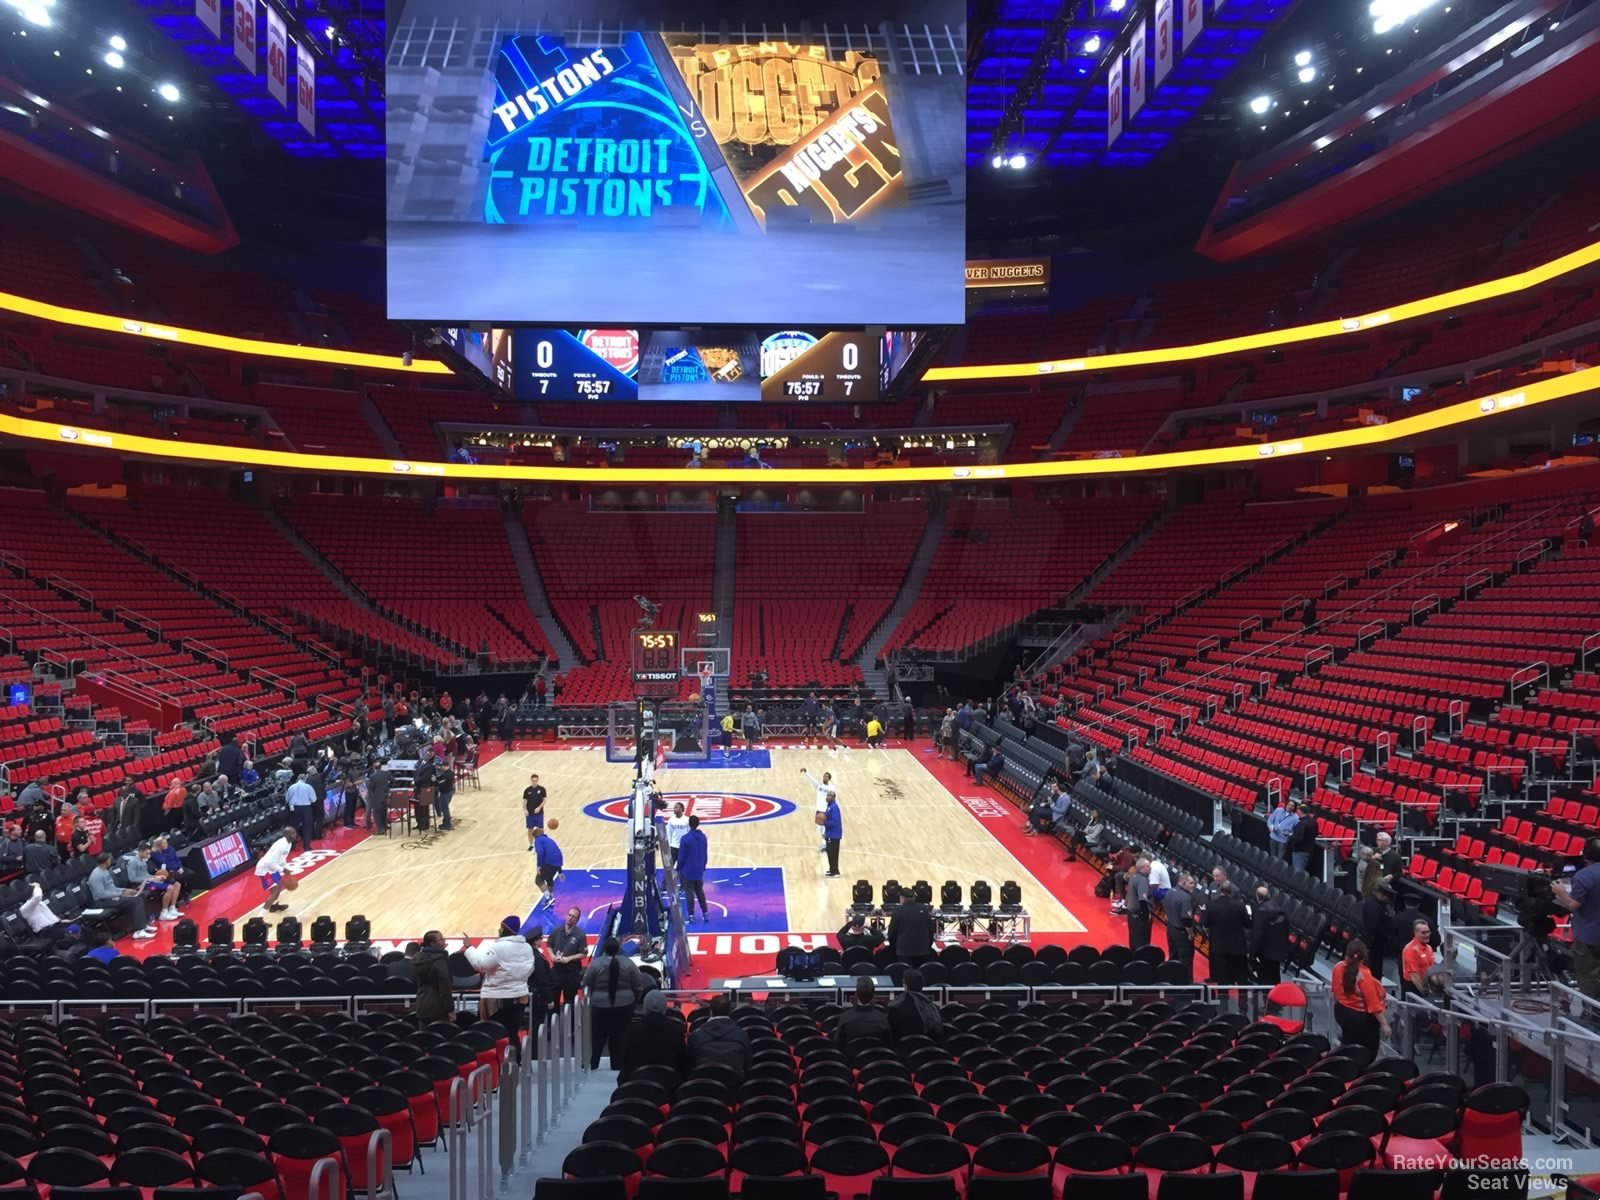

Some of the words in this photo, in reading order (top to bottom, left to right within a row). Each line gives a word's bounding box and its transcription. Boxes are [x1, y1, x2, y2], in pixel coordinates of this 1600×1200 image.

[1160, 20, 1168, 60] 3
[269, 41, 284, 87] 40
[493, 49, 614, 132] PISTONS
[527, 137, 673, 173] DETROIT
[780, 107, 878, 193] NUGGETS
[519, 178, 673, 217] PISTONS
[965, 267, 988, 279] VER
[991, 265, 1043, 278] NUGGETS
[536, 341, 553, 368] 0
[591, 336, 632, 349] DETROIT
[842, 343, 858, 370] 0
[539, 380, 549, 394] 7
[576, 381, 611, 394] 75:57
[787, 382, 820, 395] 75:57
[844, 382, 853, 396] 7
[640, 634, 674, 648] 75:57
[635, 880, 645, 923] NBA
